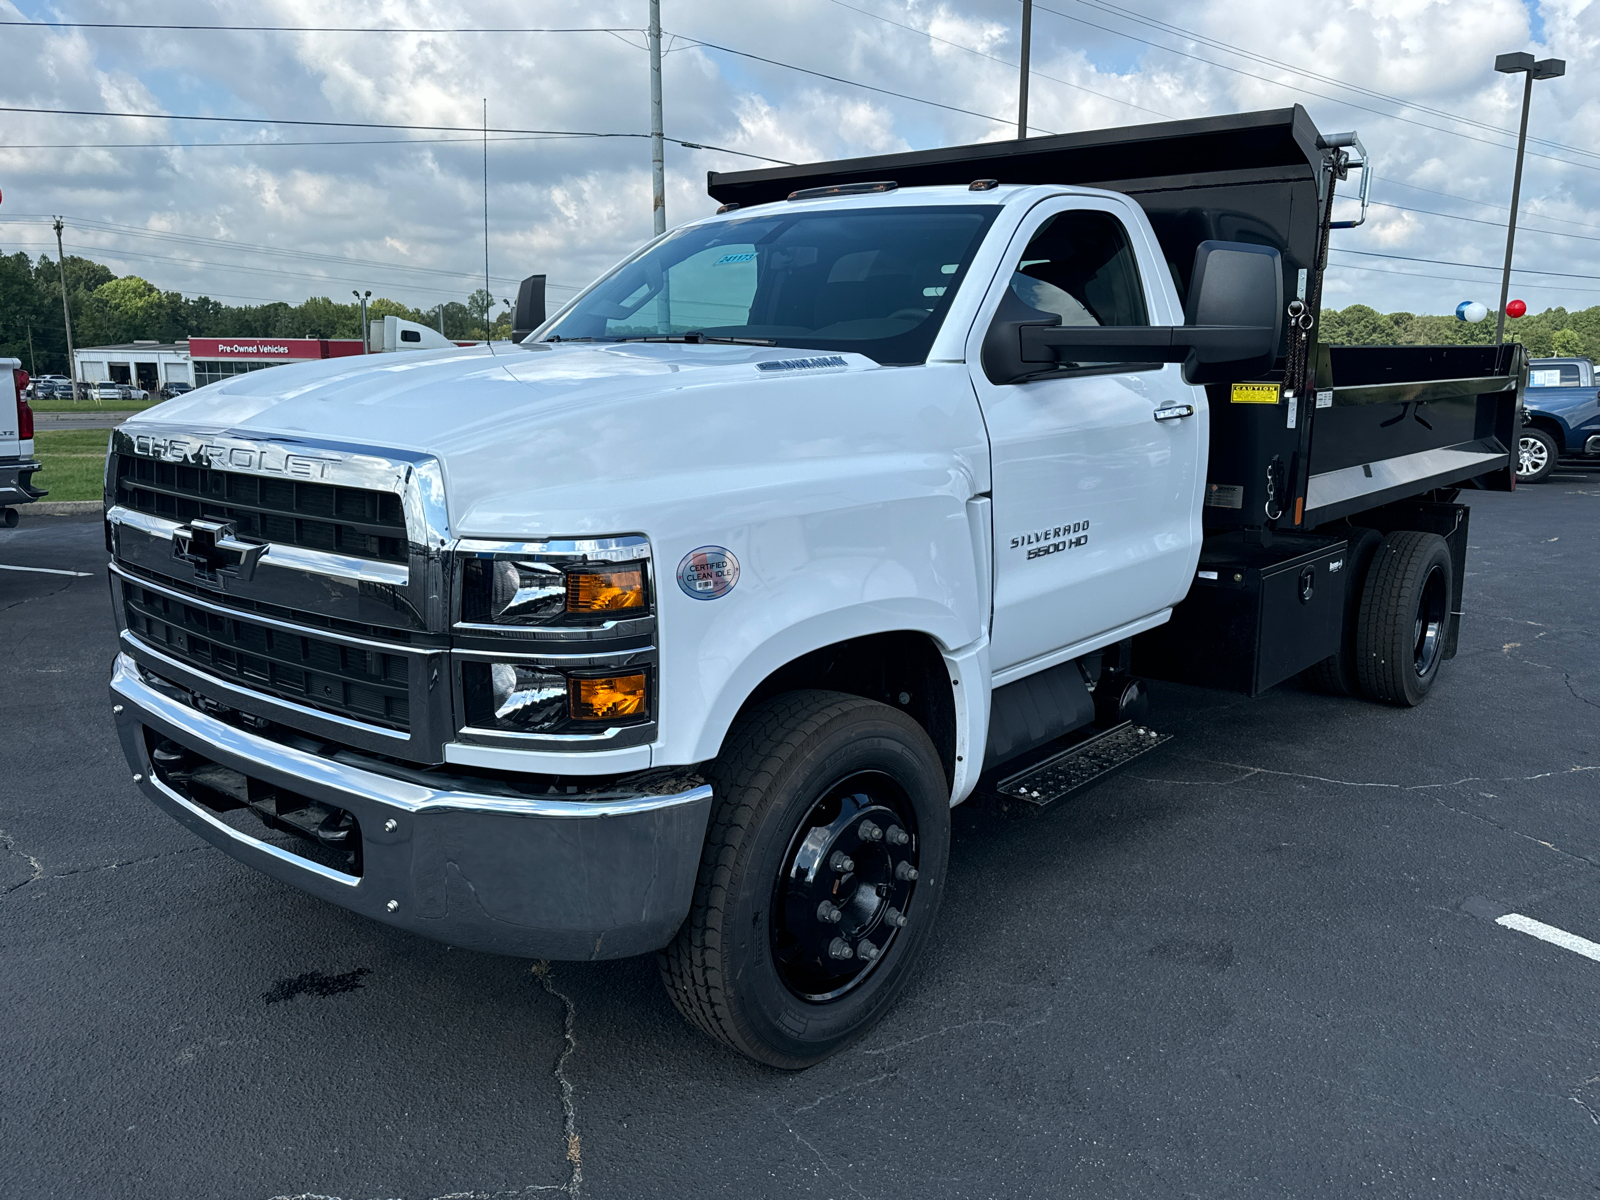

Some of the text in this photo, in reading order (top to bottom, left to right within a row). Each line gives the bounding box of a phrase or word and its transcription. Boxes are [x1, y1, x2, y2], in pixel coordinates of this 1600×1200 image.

[218, 344, 289, 354] Pre-Owned Vehicles
[133, 435, 343, 480] CHEVROLET
[1009, 519, 1090, 549] SILVERADO
[1026, 534, 1088, 560] 5500 HD
[686, 568, 732, 582] CLEAN IDLE
[689, 560, 728, 573] CERTIFIED
